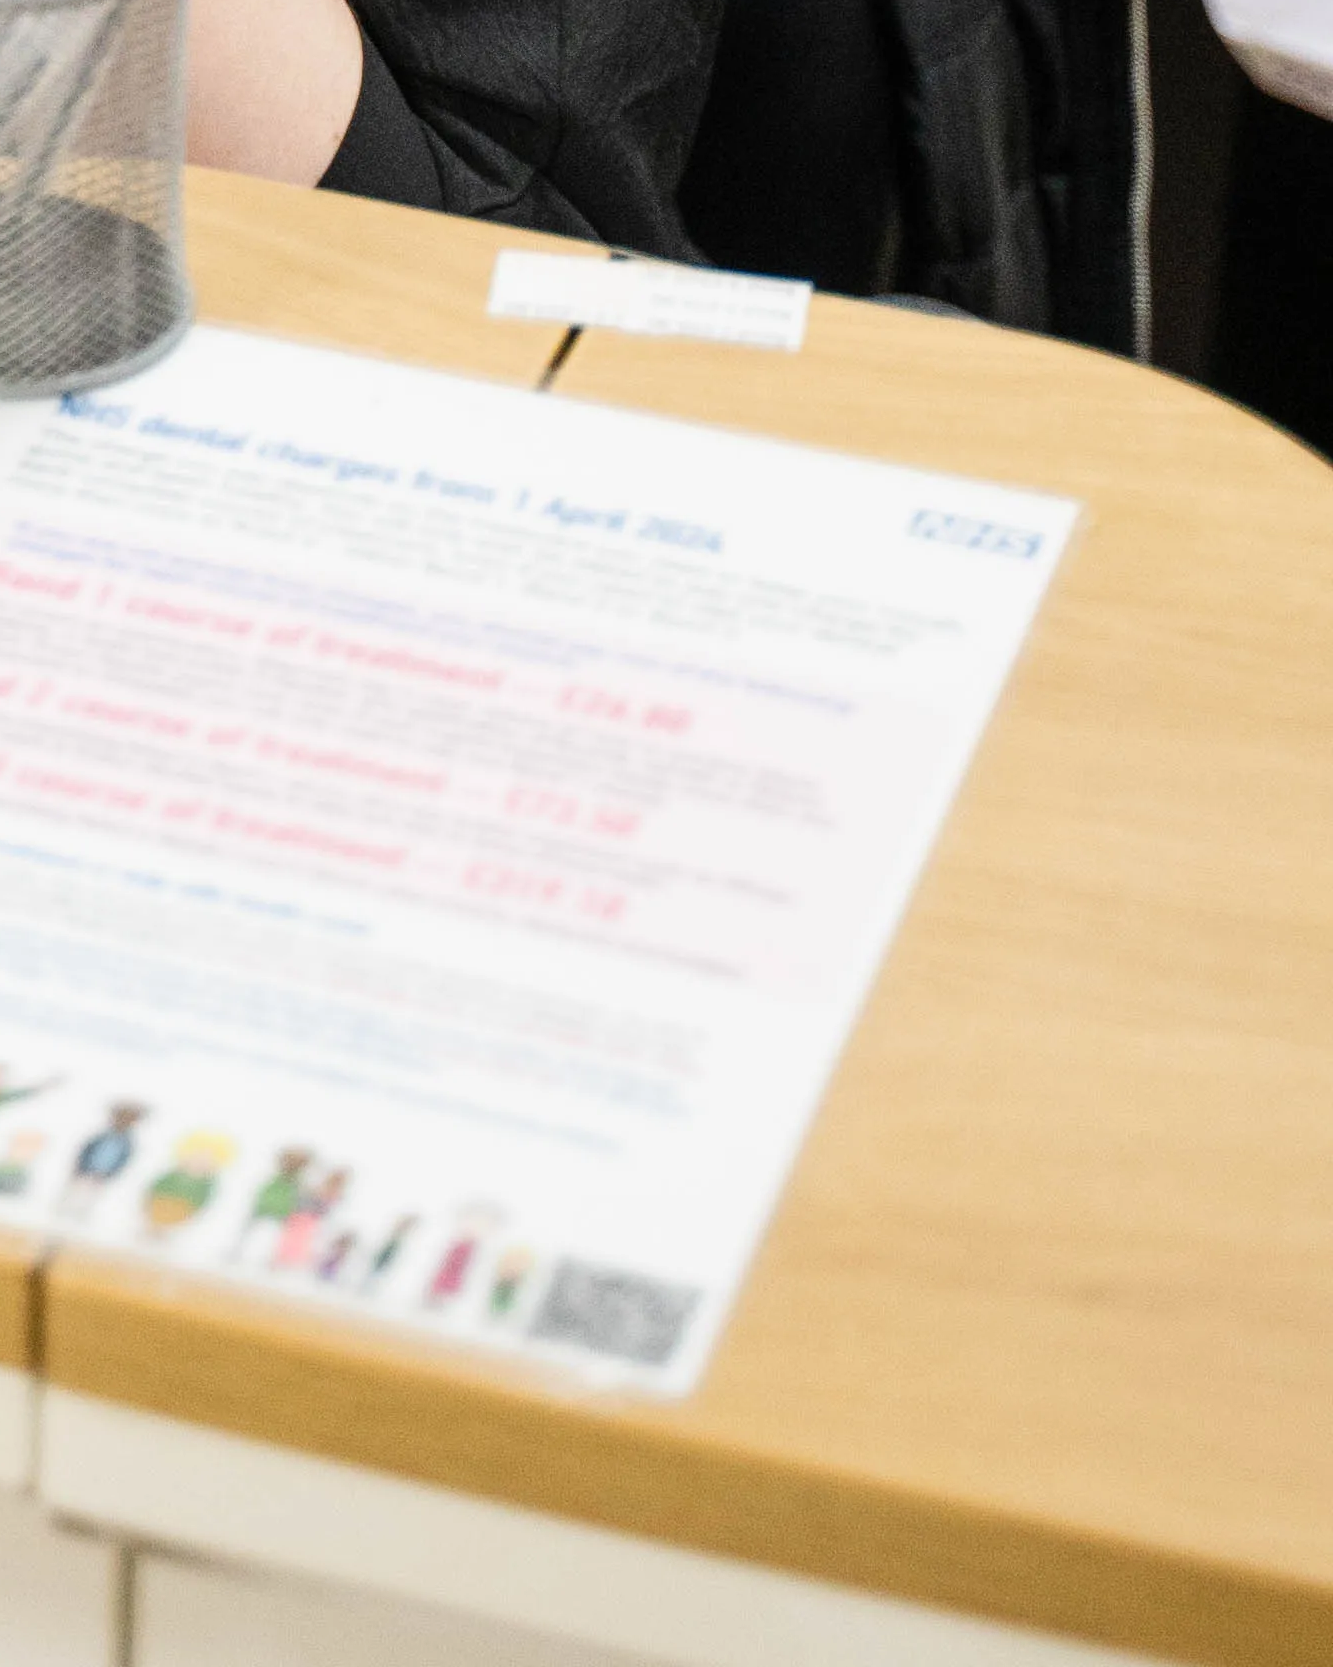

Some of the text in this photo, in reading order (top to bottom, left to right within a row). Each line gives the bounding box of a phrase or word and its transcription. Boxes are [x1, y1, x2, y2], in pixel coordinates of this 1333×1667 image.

[137, 415, 250, 454] dental
[256, 441, 399, 485] charges
[542, 496, 628, 533] April
